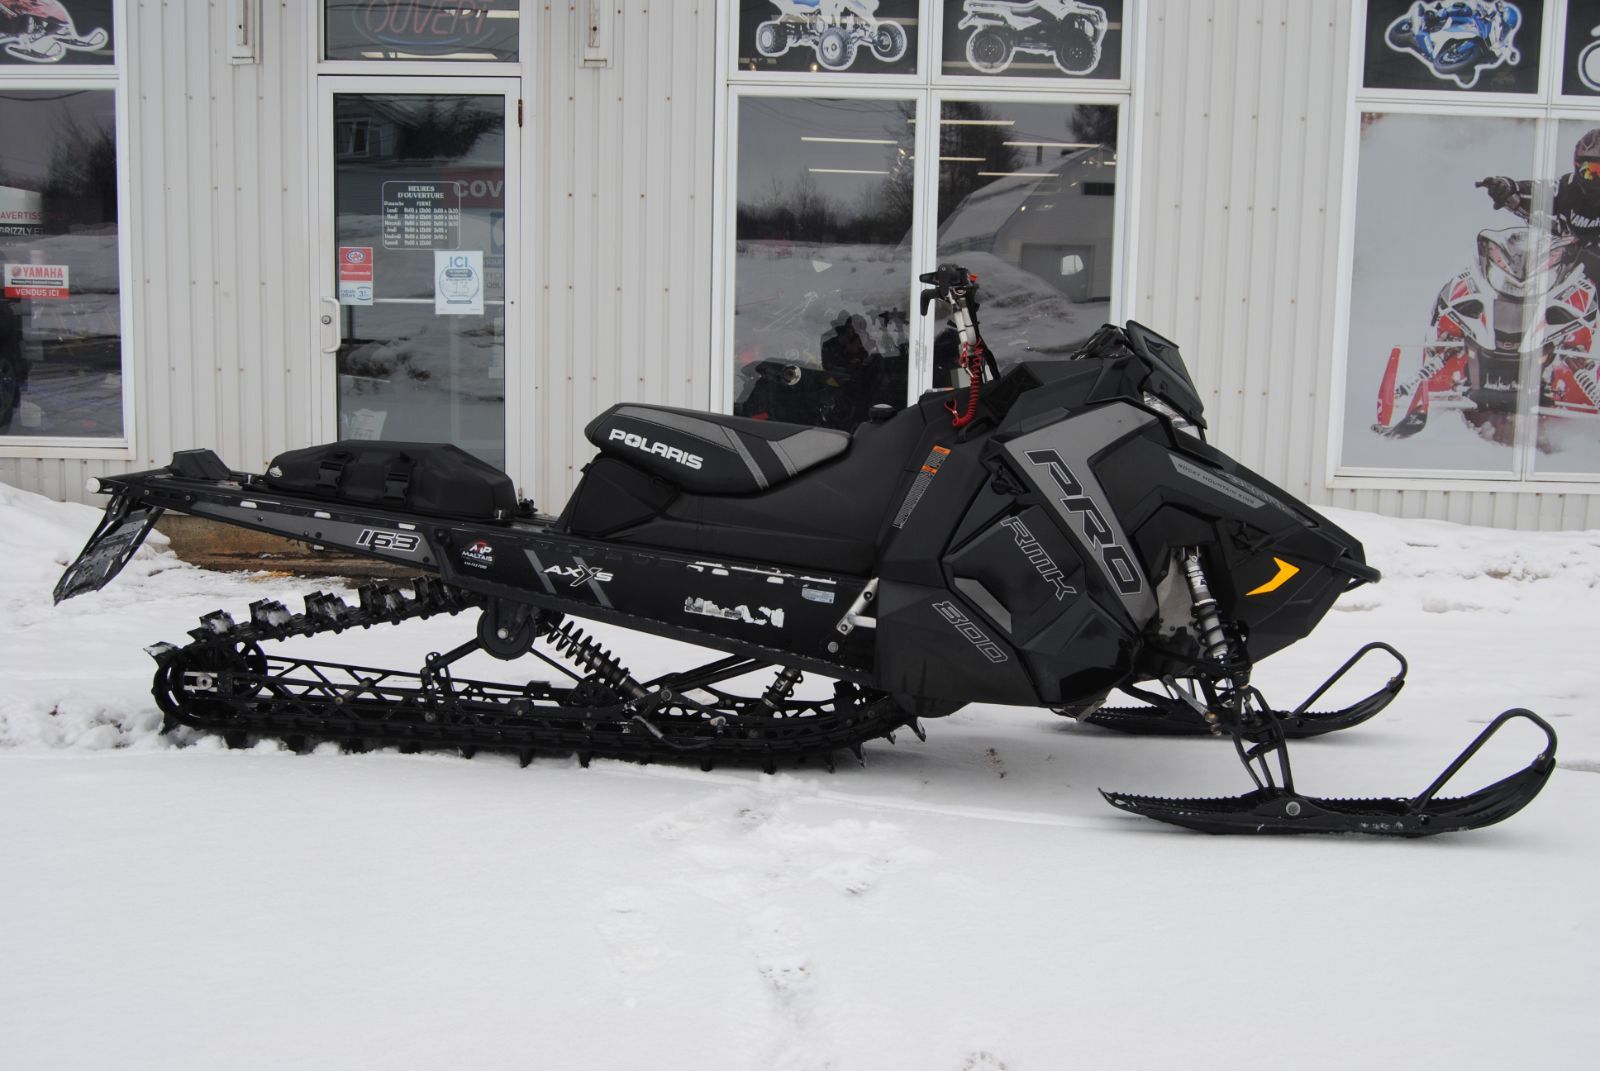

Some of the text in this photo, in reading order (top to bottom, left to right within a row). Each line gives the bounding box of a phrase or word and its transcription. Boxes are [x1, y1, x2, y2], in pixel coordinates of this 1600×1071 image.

[366, 0, 495, 34] OUVERT
[22, 266, 64, 278] YAMAHA
[449, 256, 468, 268] ICI
[15, 288, 60, 297] VENDUS ICI
[608, 428, 704, 470] POLARIS
[1202, 475, 1237, 496] MOUNTAIN
[1023, 448, 1142, 596] PRO
[355, 528, 421, 552] 163
[461, 551, 493, 562] MALTAIS
[1000, 515, 1078, 601] RMK
[931, 600, 1009, 664] 800
